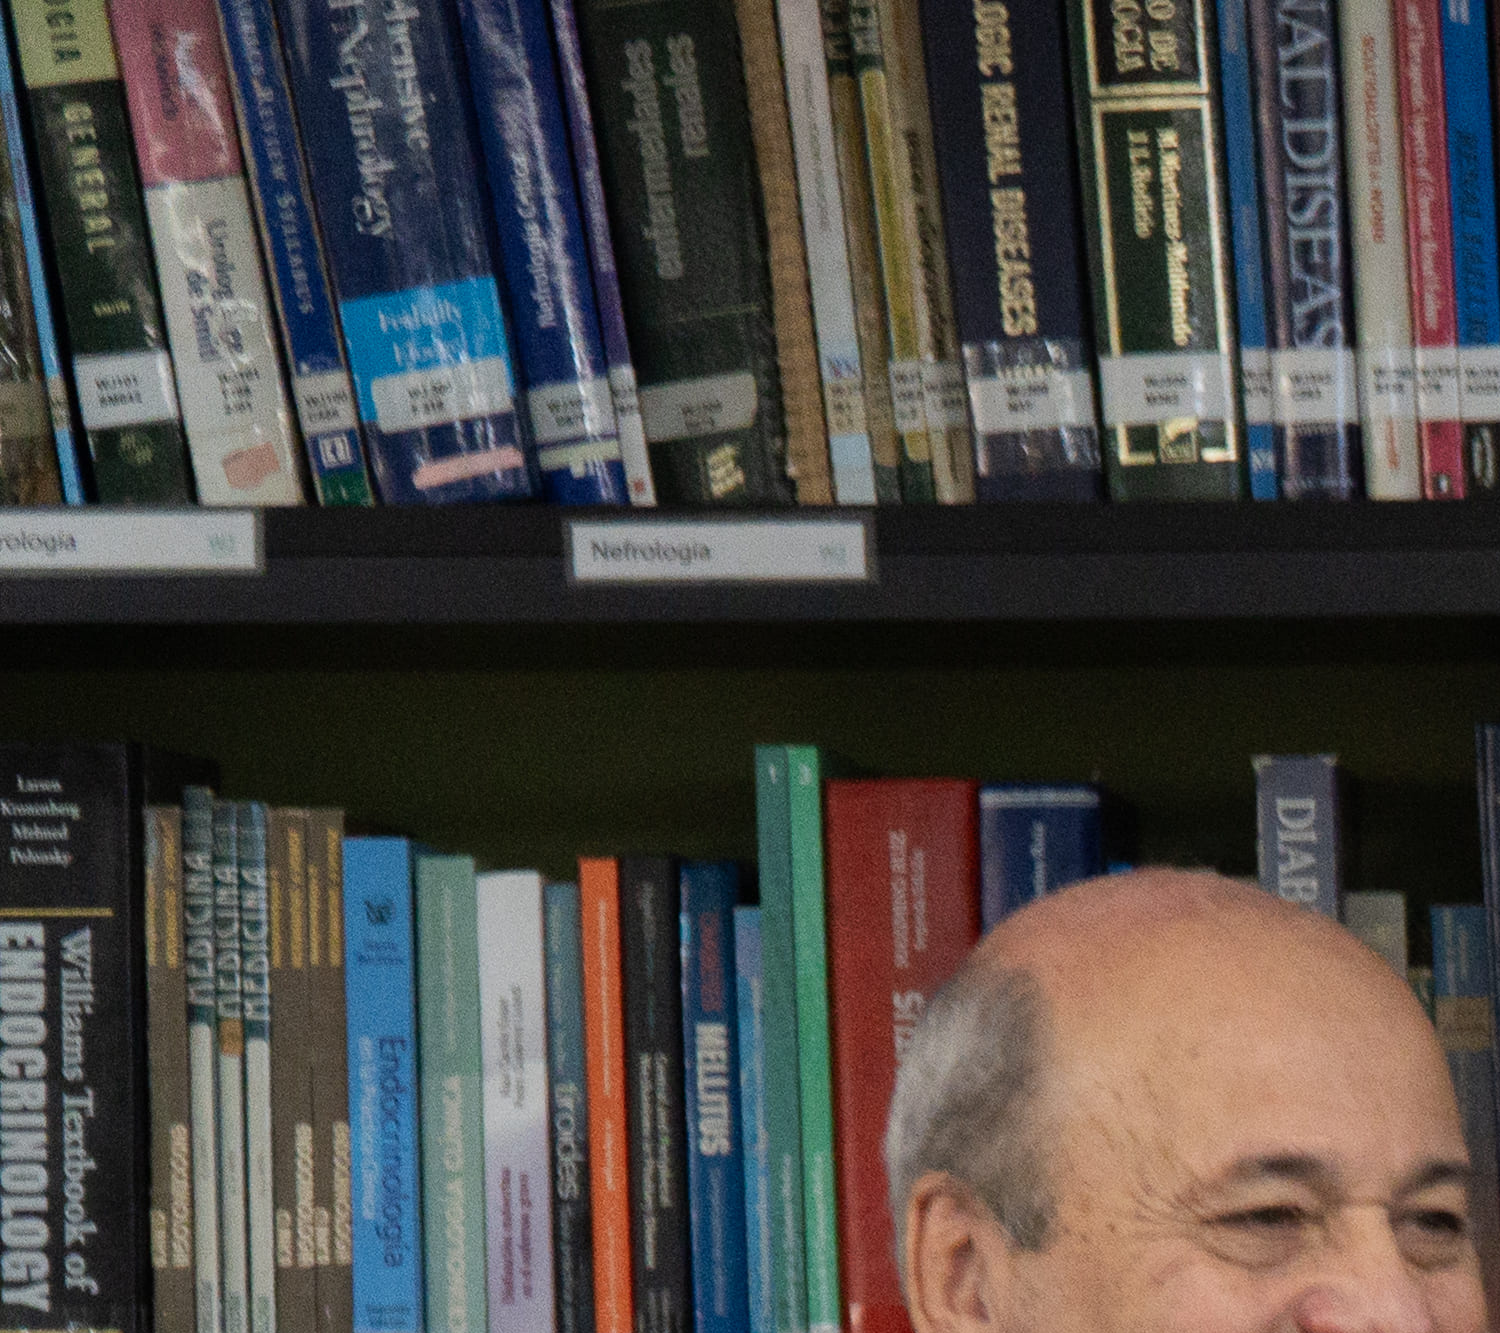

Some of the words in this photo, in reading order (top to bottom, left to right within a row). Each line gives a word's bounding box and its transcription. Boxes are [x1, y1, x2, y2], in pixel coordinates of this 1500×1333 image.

[664, 32, 708, 158] renales
[1148, 30, 1181, 73] DE
[62, 101, 117, 254] GENERAL
[330, 19, 397, 240] Nephrology
[620, 40, 682, 279] enfermedades
[979, 81, 1023, 185] RENAL
[989, 188, 1038, 338] DISEASES
[1283, 117, 1341, 348] DISEAS
[1461, 229, 1488, 345] FAILUR
[590, 538, 712, 564] Nefrología
[1275, 797, 1319, 905] DIAB
[60, 926, 96, 1082] Williams
[184, 851, 215, 1007] MEDICINA
[213, 863, 241, 1018] MEDICINA
[241, 866, 271, 1022] MEDICINA
[0, 922, 51, 1313] ENDOCRINOLOGY
[376, 1035, 409, 1268] Endocrinología
[553, 1081, 584, 1201] tiroides
[694, 1022, 731, 1156] MELLITUS
[61, 1087, 98, 1248] Textbook
[62, 1252, 100, 1296] of
